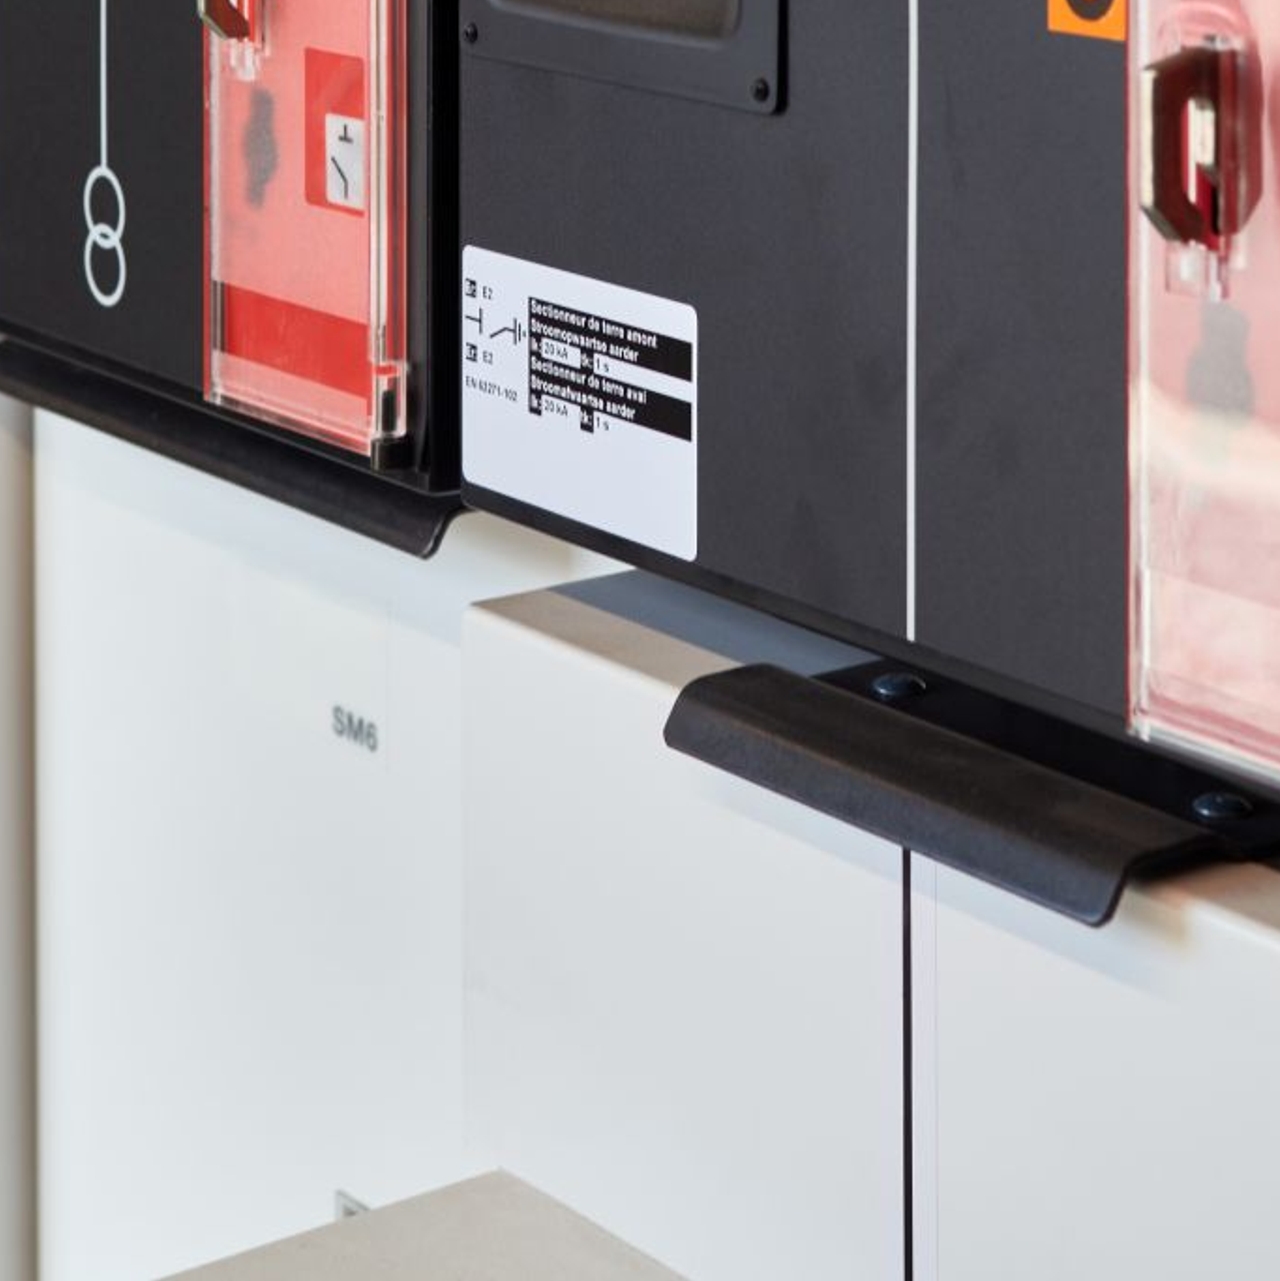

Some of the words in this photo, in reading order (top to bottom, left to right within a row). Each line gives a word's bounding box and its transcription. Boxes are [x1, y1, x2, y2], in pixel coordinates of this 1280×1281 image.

[482, 286, 494, 300] E2
[531, 299, 586, 328] Sectionneur
[588, 317, 600, 332] de
[602, 320, 624, 339] terre
[627, 330, 658, 350] amont
[610, 344, 639, 363] aarder
[465, 376, 476, 389] EN
[531, 355, 586, 385] Sectionneur
[588, 373, 600, 390] de
[602, 376, 624, 397] terre
[627, 387, 648, 404] aval
[606, 401, 636, 420] aarder
[332, 705, 377, 752] SM6
